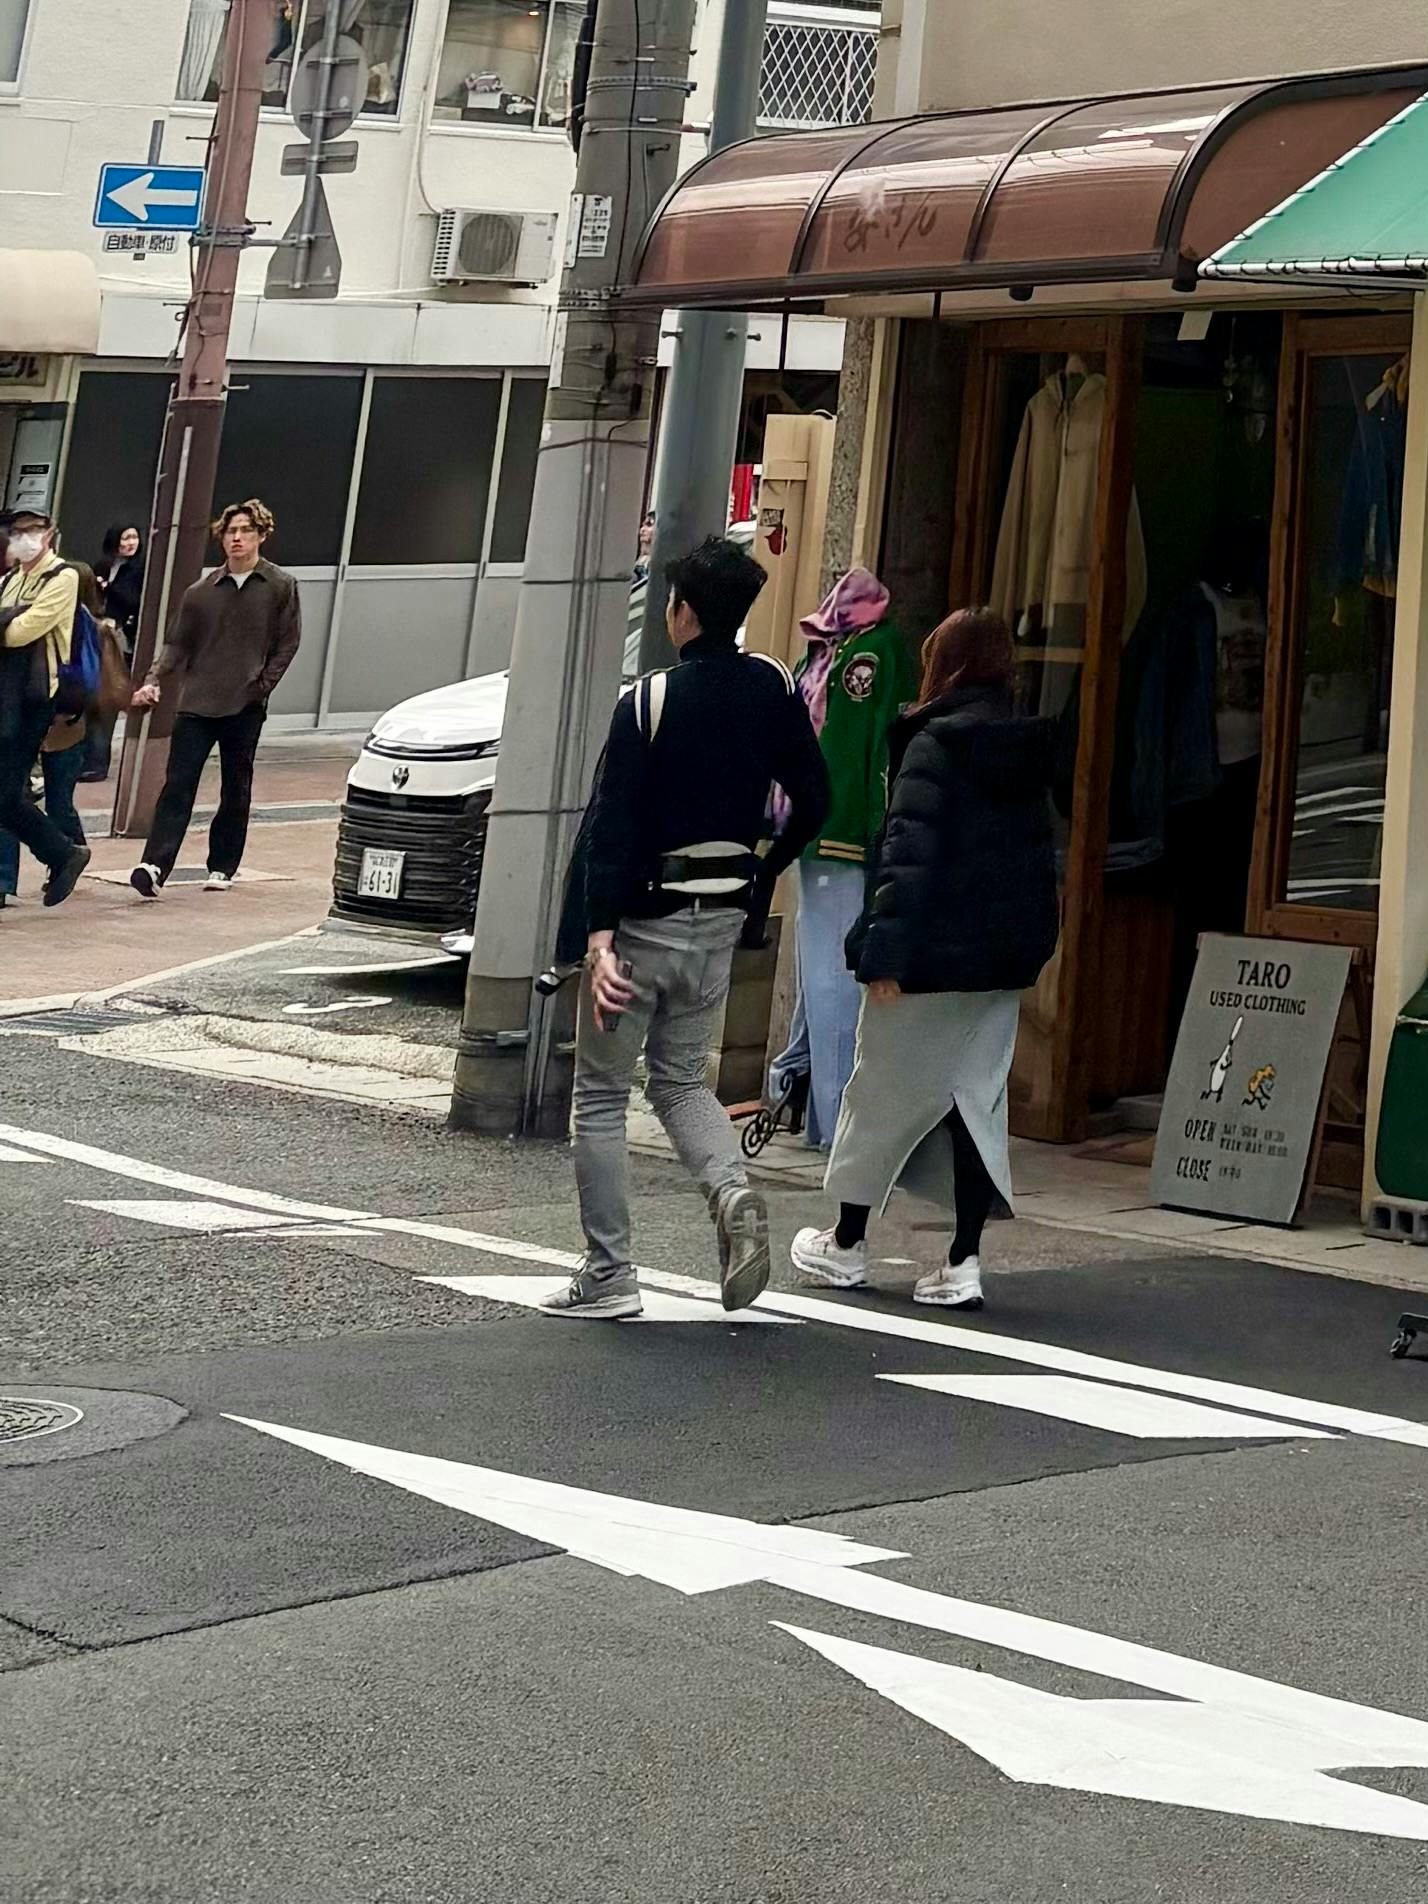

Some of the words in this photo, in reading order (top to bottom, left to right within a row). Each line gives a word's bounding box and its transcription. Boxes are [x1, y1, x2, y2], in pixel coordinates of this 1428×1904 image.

[1237, 959, 1291, 989] TARO
[1210, 991, 1242, 1008] USED
[1243, 994, 1306, 1015] CLOTHING
[1185, 1119, 1216, 1142] OPEN
[1177, 1156, 1212, 1182] CLOSE
